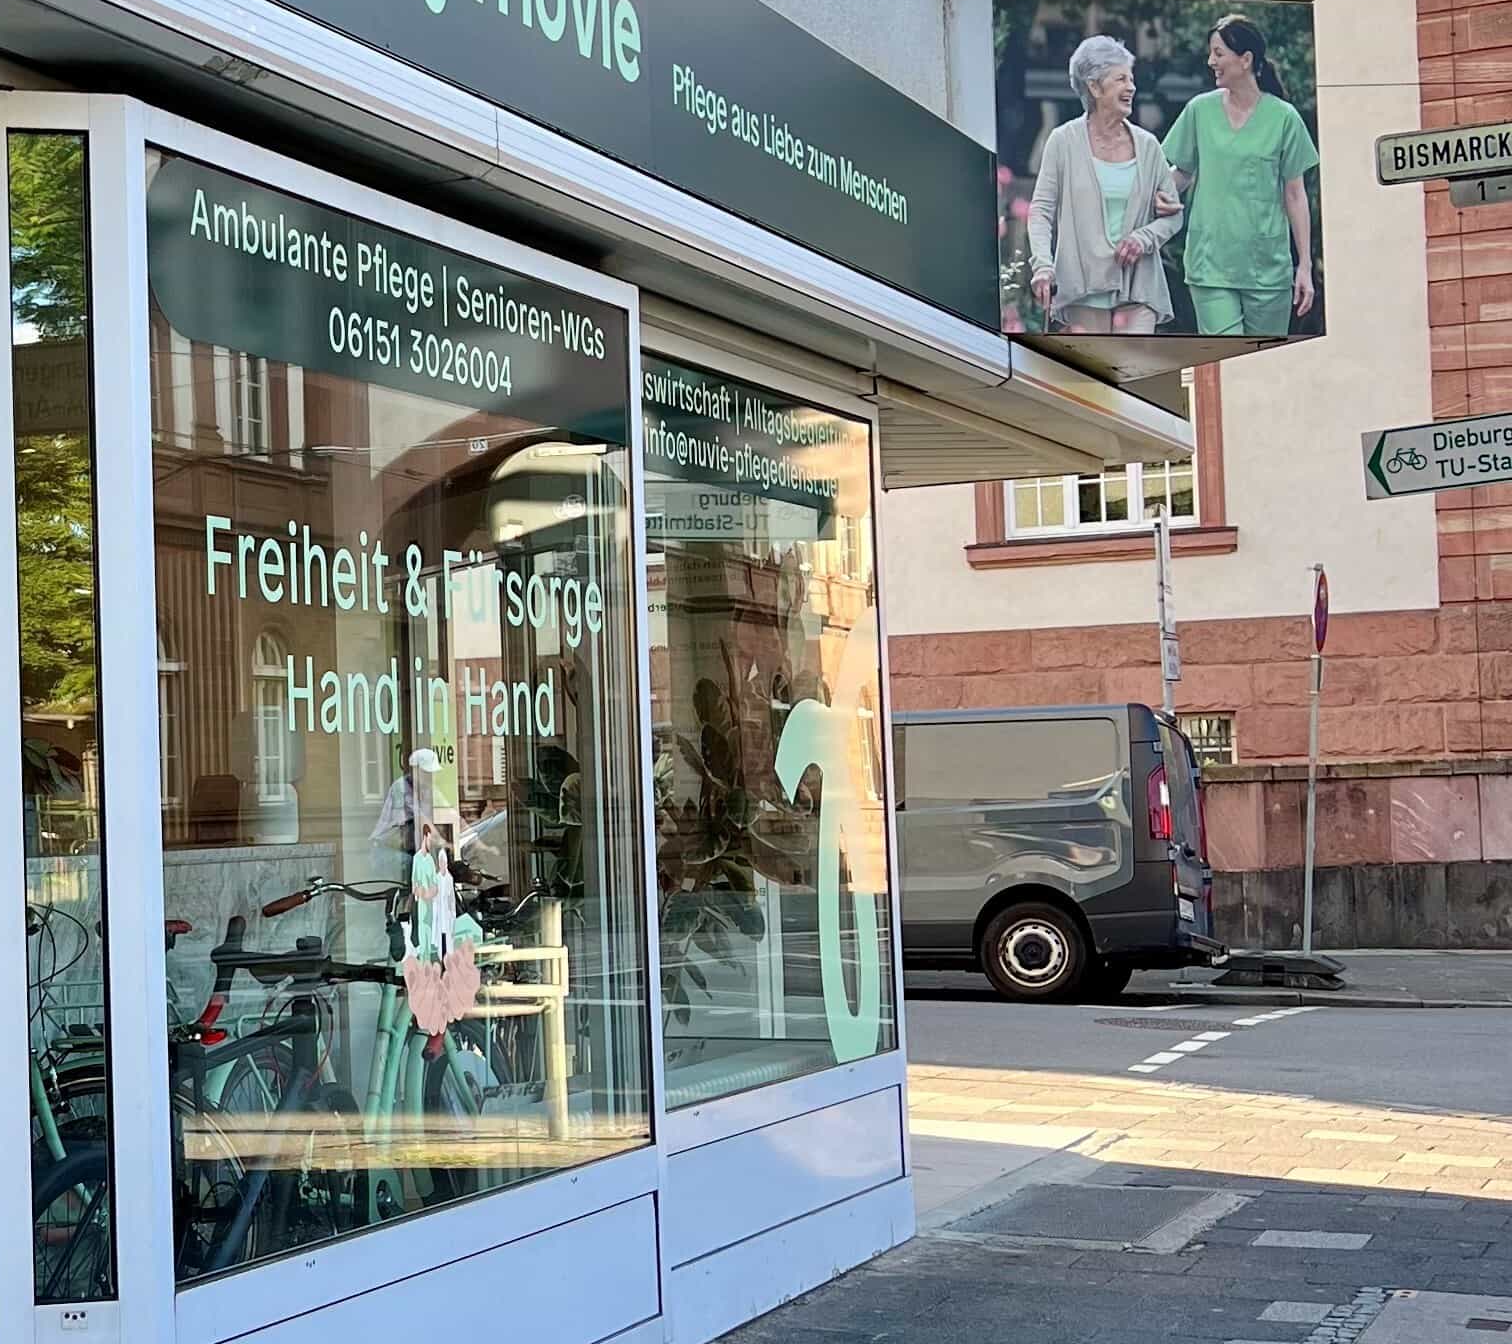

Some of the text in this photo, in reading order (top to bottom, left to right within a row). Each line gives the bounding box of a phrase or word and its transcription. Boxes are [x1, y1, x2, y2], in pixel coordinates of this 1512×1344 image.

[672, 63, 908, 225] Pflege aus Liebe zum Menschen
[1393, 131, 1512, 171] BISMARCK
[1477, 181, 1486, 201] 1
[190, 188, 348, 282] Ambulante
[357, 242, 434, 308] Pflege
[456, 275, 605, 360] Senioren-WGs
[328, 307, 513, 397] 06151 3026004
[642, 370, 731, 423] swirtschaft
[644, 418, 839, 499] info@nuvie-pflegedienst.de
[1433, 427, 1512, 452] Dieburg
[1435, 454, 1512, 479] TU-Sta
[205, 515, 603, 648] Freiheit & Fürsorge
[286, 655, 556, 737] Hand in Hand
